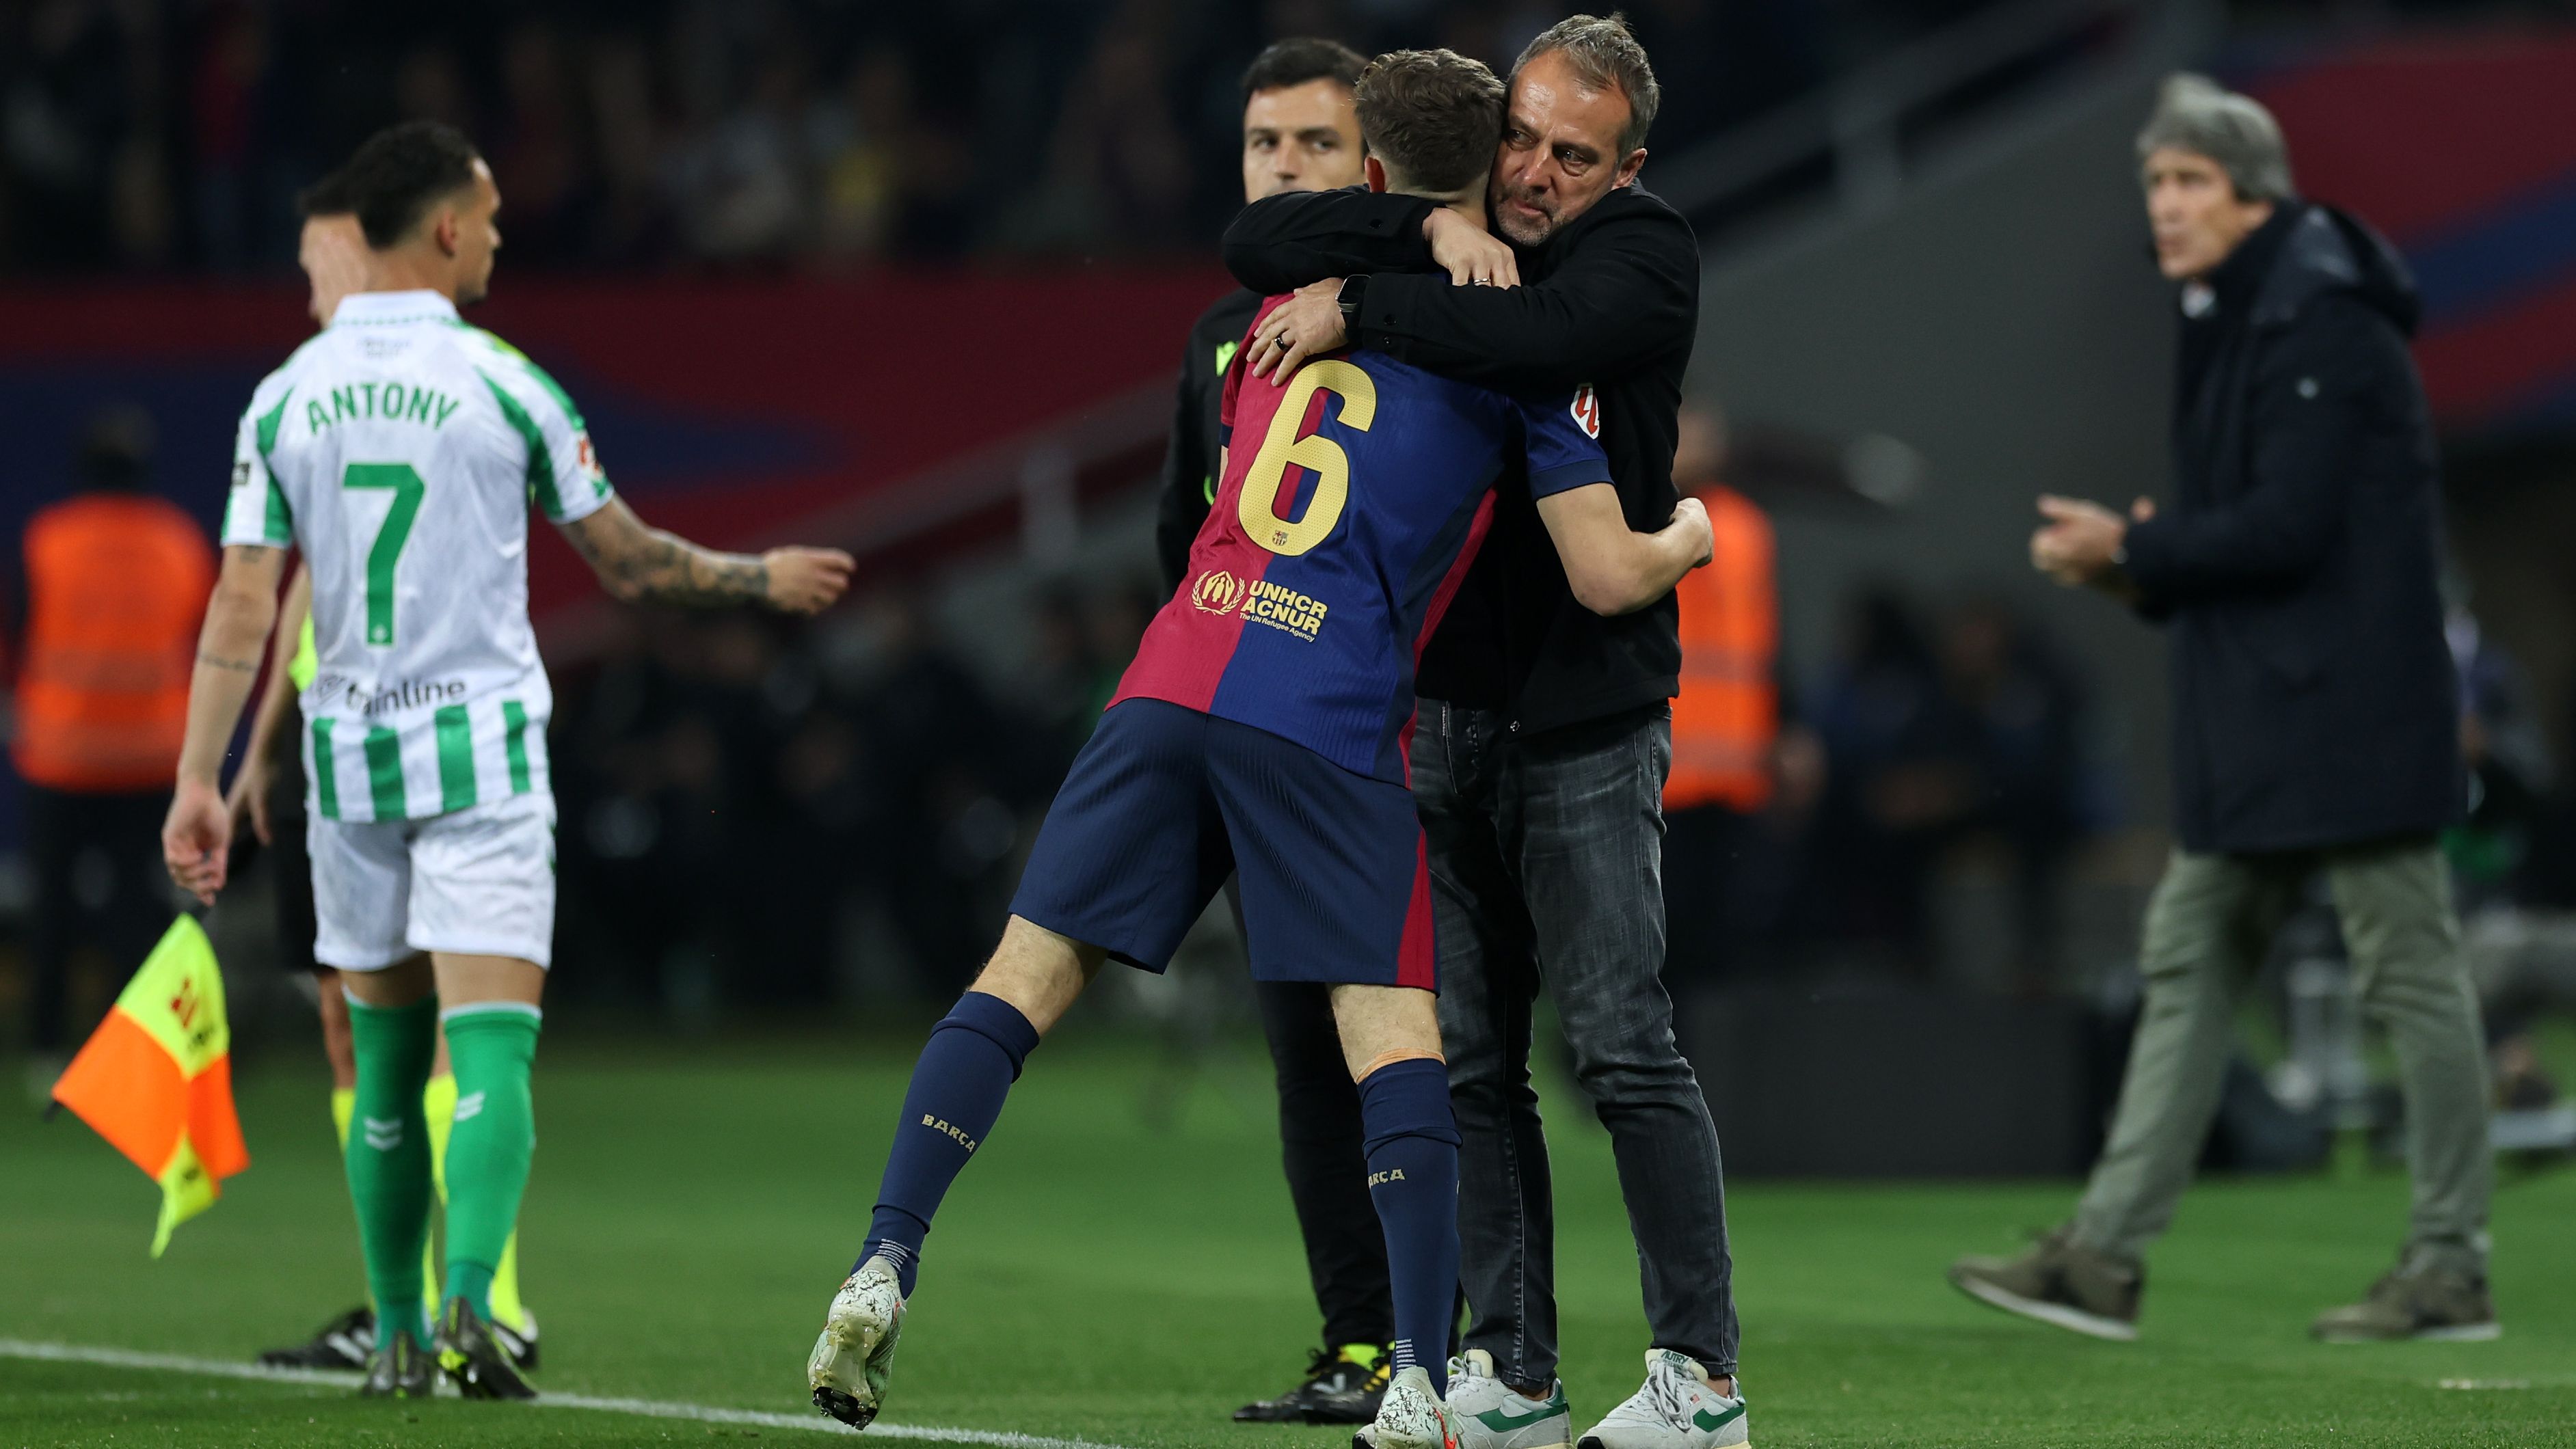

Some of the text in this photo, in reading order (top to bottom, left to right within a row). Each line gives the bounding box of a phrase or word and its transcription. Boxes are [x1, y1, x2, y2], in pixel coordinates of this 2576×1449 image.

[307, 382, 460, 435] ANTONY
[1238, 360, 1376, 556] 6
[343, 463, 425, 646] 7
[1240, 597, 1321, 636] ACNUR
[1248, 580, 1328, 620] UNHCR
[1239, 612, 1315, 643] The UN Refugee Agency
[1661, 1350, 1689, 1365] AUTRY
